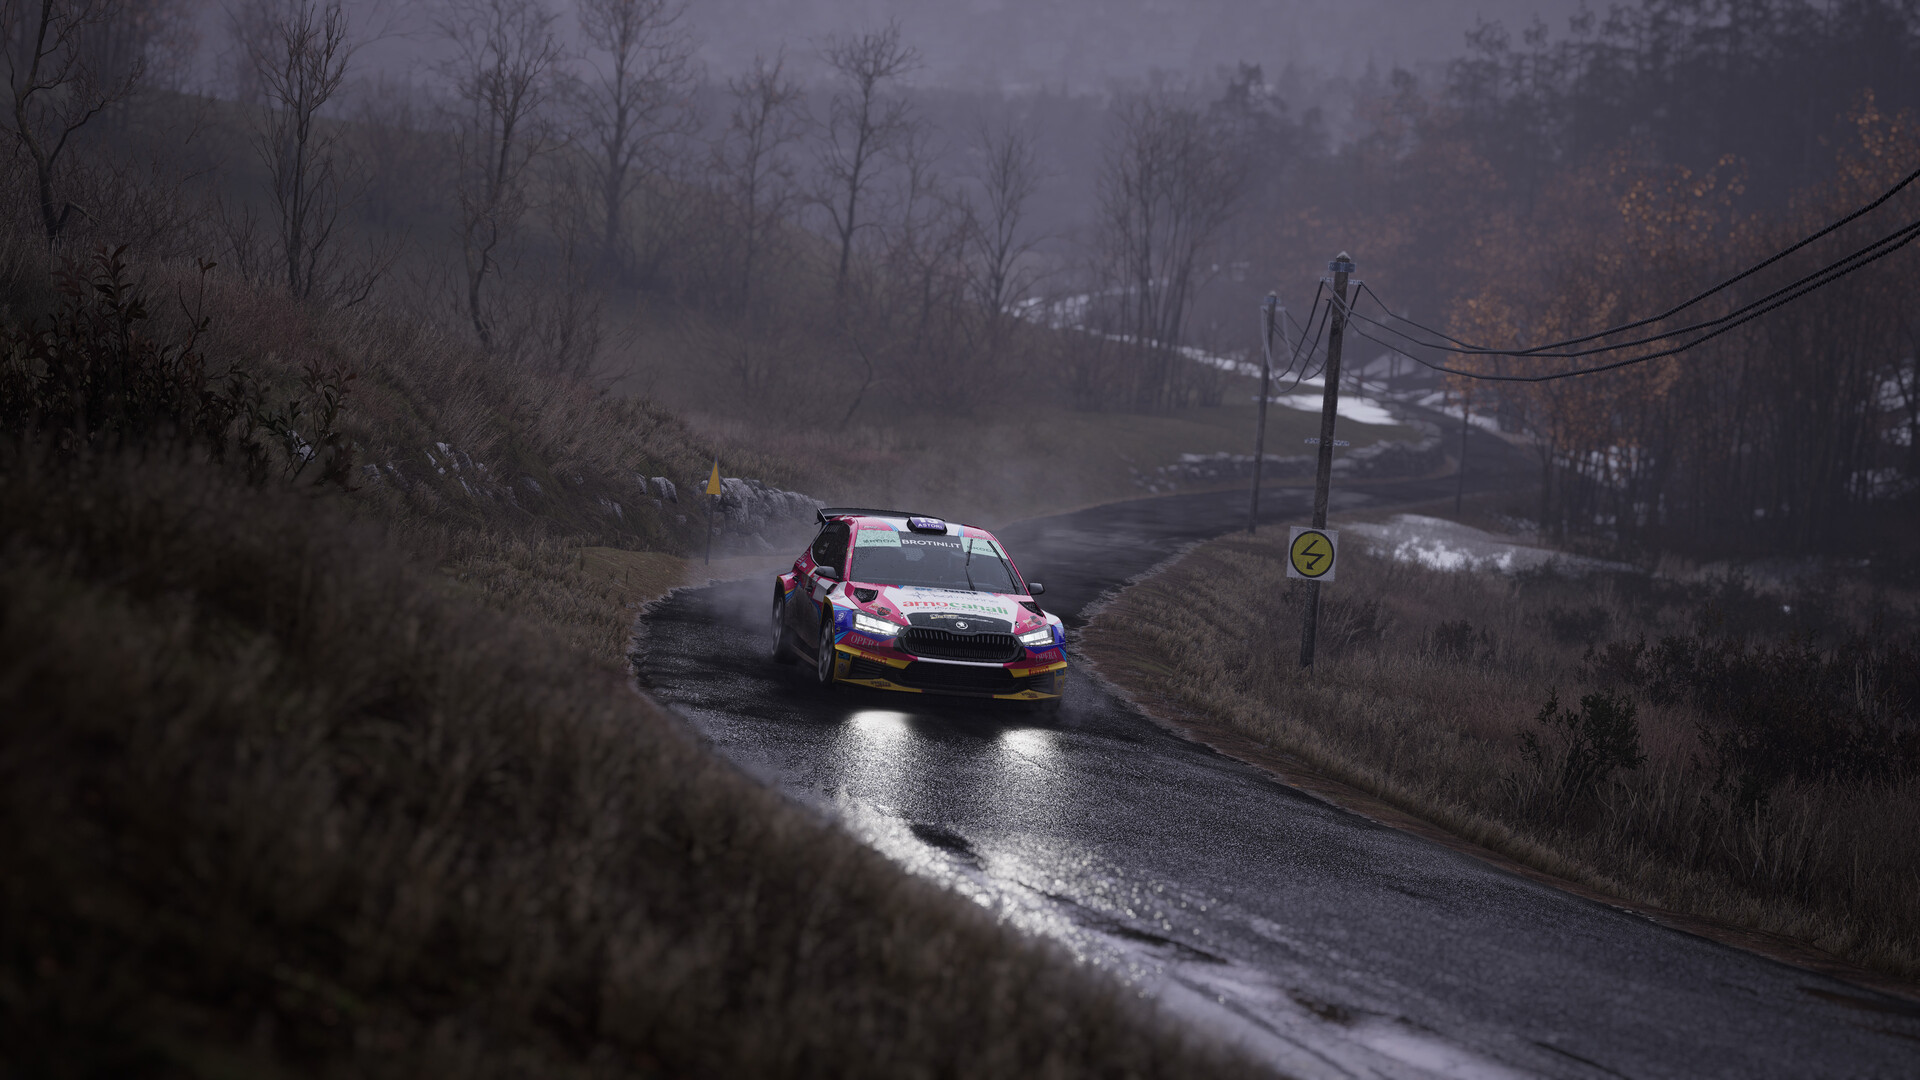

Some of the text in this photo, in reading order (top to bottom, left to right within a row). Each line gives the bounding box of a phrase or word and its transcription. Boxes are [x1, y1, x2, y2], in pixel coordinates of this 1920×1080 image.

[901, 539, 961, 549] BROTINI.IT
[902, 600, 1009, 615] arnocanali
[850, 634, 880, 650] OPERA
[1035, 650, 1058, 663] OPERA
